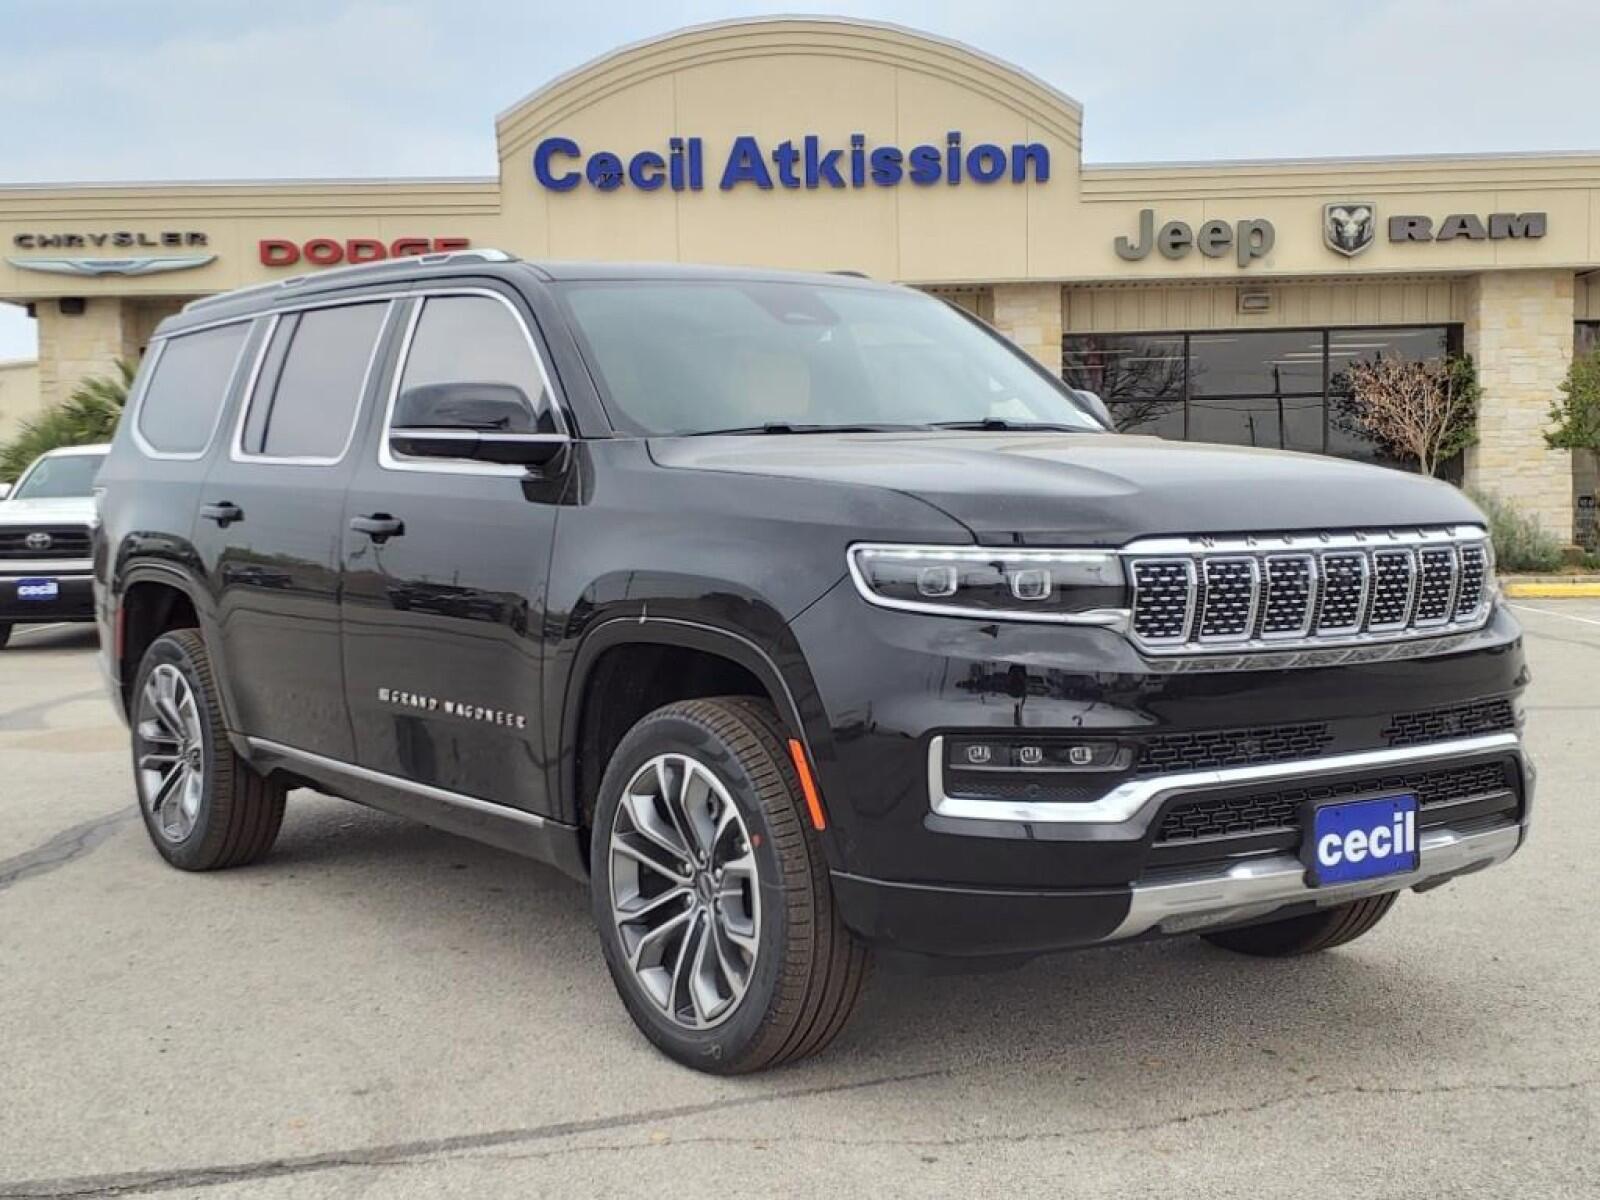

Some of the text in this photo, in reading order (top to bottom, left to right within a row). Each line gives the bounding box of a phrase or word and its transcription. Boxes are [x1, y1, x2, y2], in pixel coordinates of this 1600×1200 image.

[533, 131, 1050, 192] Cecil Atkission
[13, 233, 208, 248] CHRYSLER
[1114, 209, 1275, 267] Jeep
[1388, 212, 1547, 242] RAM
[1318, 810, 1415, 867] cecil
